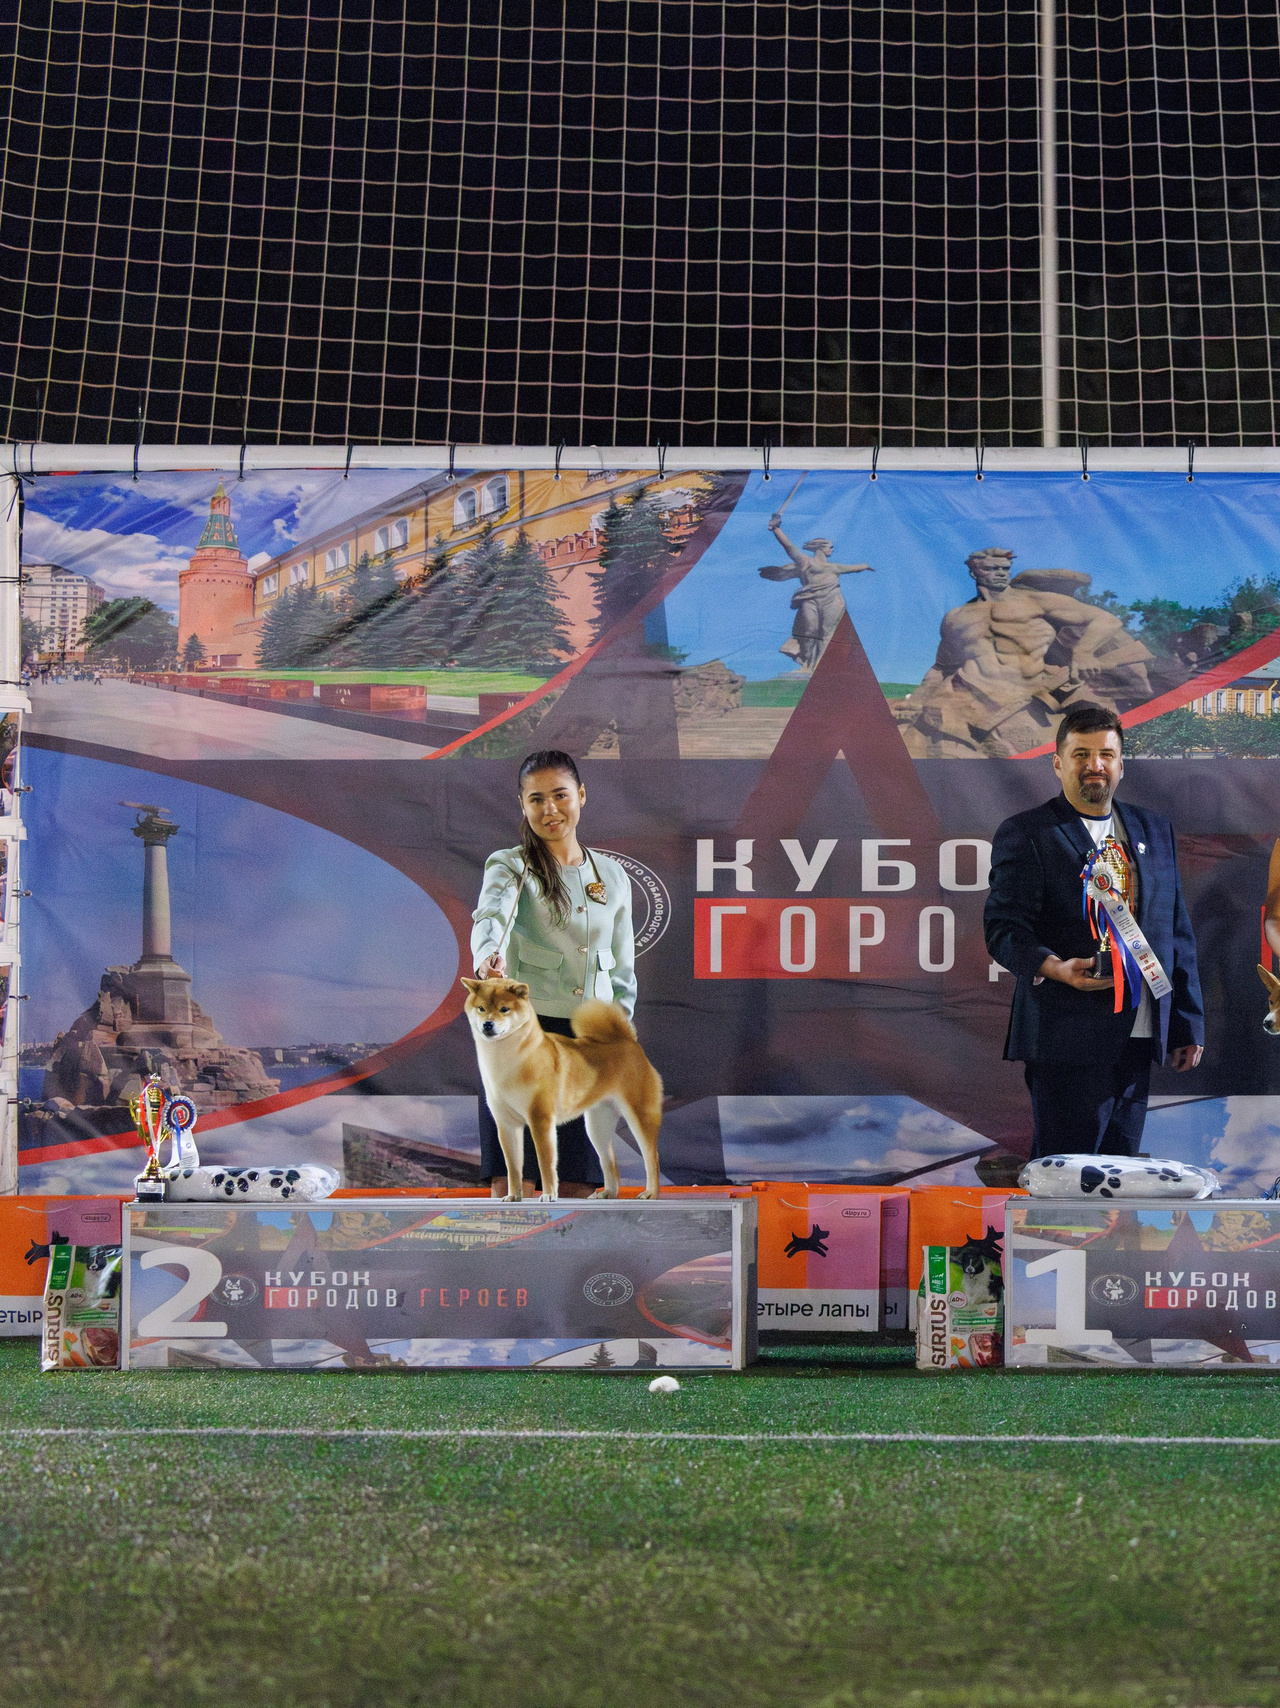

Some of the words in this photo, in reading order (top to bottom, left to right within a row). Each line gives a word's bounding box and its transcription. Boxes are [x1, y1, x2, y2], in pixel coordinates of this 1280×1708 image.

[710, 906, 1010, 981] ГОРО
[137, 1246, 228, 1338] 2
[265, 1271, 370, 1286] КУБОК
[268, 1289, 398, 1309] ГОРОДОВ
[420, 1288, 528, 1308] ГЕРОЕВ
[1025, 1249, 1113, 1345] 1
[1145, 1271, 1250, 1287] КУБОК
[1148, 1289, 1277, 1310] ГОРОДОВ
[47, 1294, 64, 1362] SIRIUS
[818, 1304, 869, 1317] лапы
[930, 1299, 947, 1366] SIRIUS
